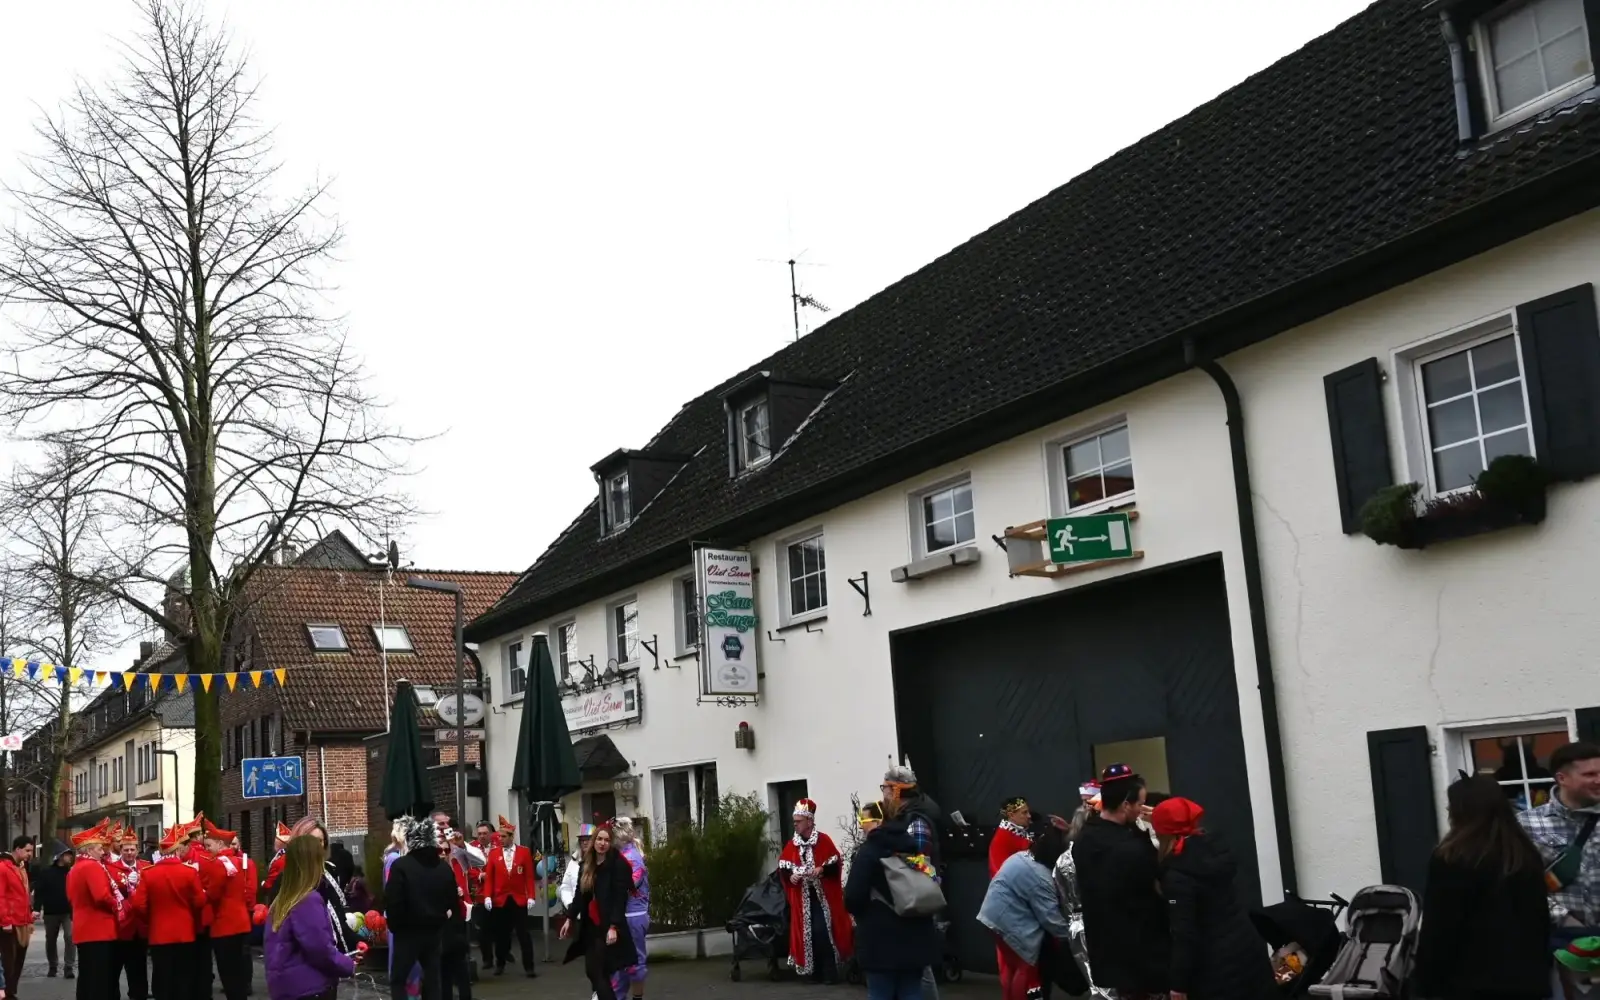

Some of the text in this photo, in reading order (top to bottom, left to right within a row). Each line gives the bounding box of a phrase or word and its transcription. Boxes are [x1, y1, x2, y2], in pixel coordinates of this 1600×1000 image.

[708, 553, 748, 562] Restaurant
[707, 564, 727, 576] Viet
[707, 590, 753, 609] Haus
[584, 697, 601, 717] Viet
